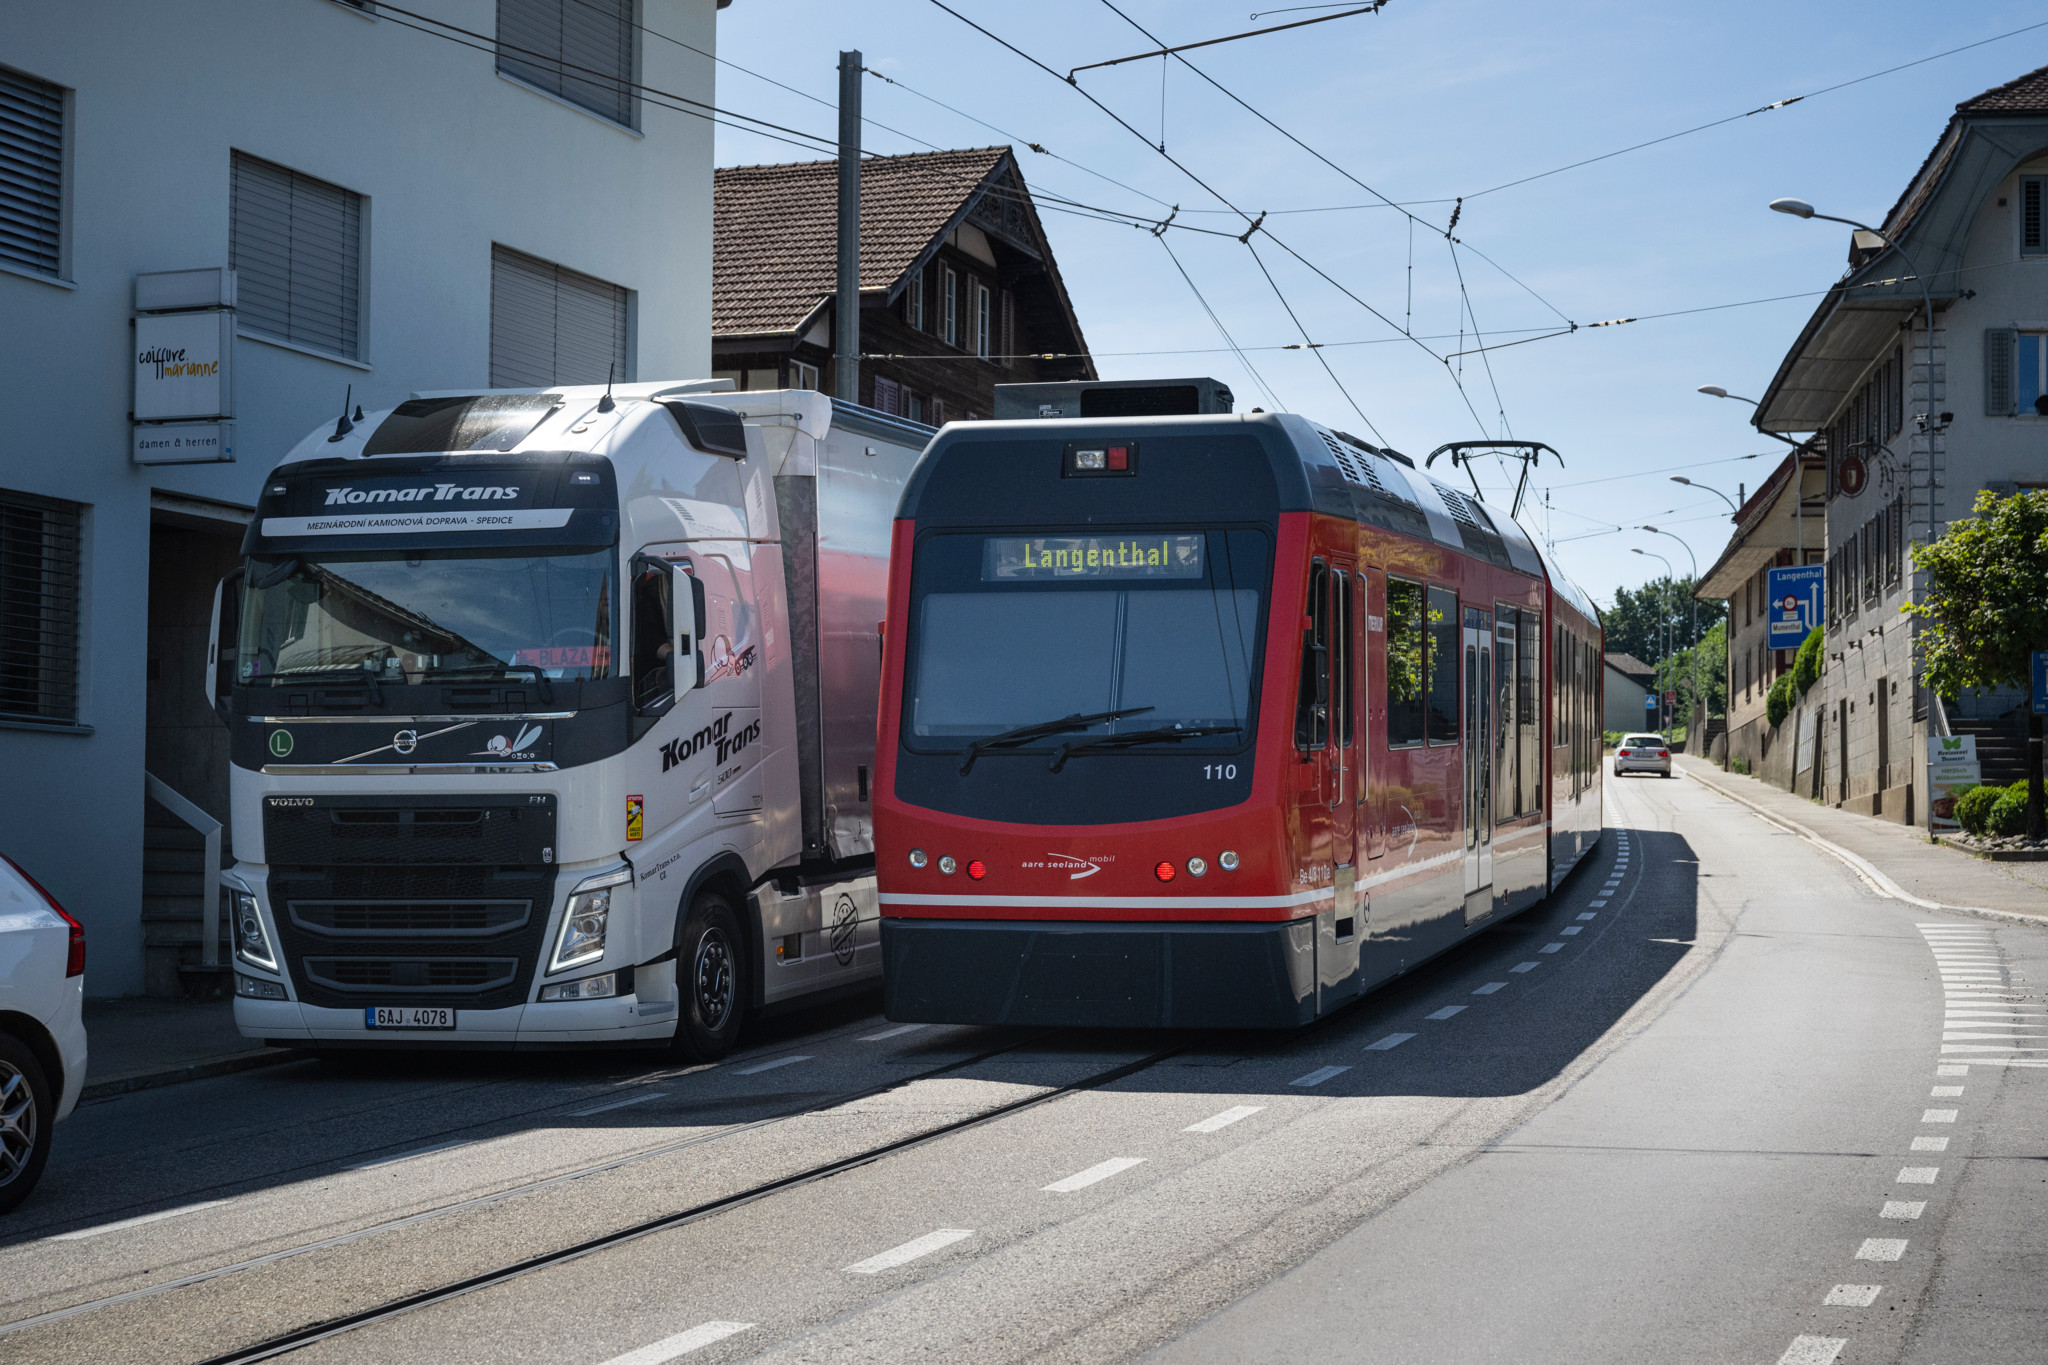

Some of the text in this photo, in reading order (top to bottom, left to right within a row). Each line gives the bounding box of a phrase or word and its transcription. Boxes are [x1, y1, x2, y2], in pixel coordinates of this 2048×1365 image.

[139, 346, 186, 380] coiffure
[164, 358, 219, 378] marianne
[139, 440, 170, 449] damen
[186, 438, 217, 447] herren
[324, 483, 519, 505] KomarTrans
[307, 518, 367, 530] MEZINÁRODNÍ
[367, 516, 424, 528] KAMIONOVÁ
[426, 516, 468, 526] DOPRAVA
[476, 516, 514, 525] SPEDICE
[1025, 540, 1168, 572] Langenthal
[1777, 569, 1822, 582] Langenthal
[276, 734, 288, 752] L
[659, 711, 732, 773] Komar
[714, 718, 760, 767] Trans
[1203, 764, 1237, 780] 110
[269, 797, 314, 807] VOLVO
[529, 796, 546, 804] FH
[1047, 859, 1087, 868] seeland
[1089, 855, 1116, 863] mobil
[1299, 868, 1307, 884] Be
[378, 1009, 447, 1025] 6AJ 4078
